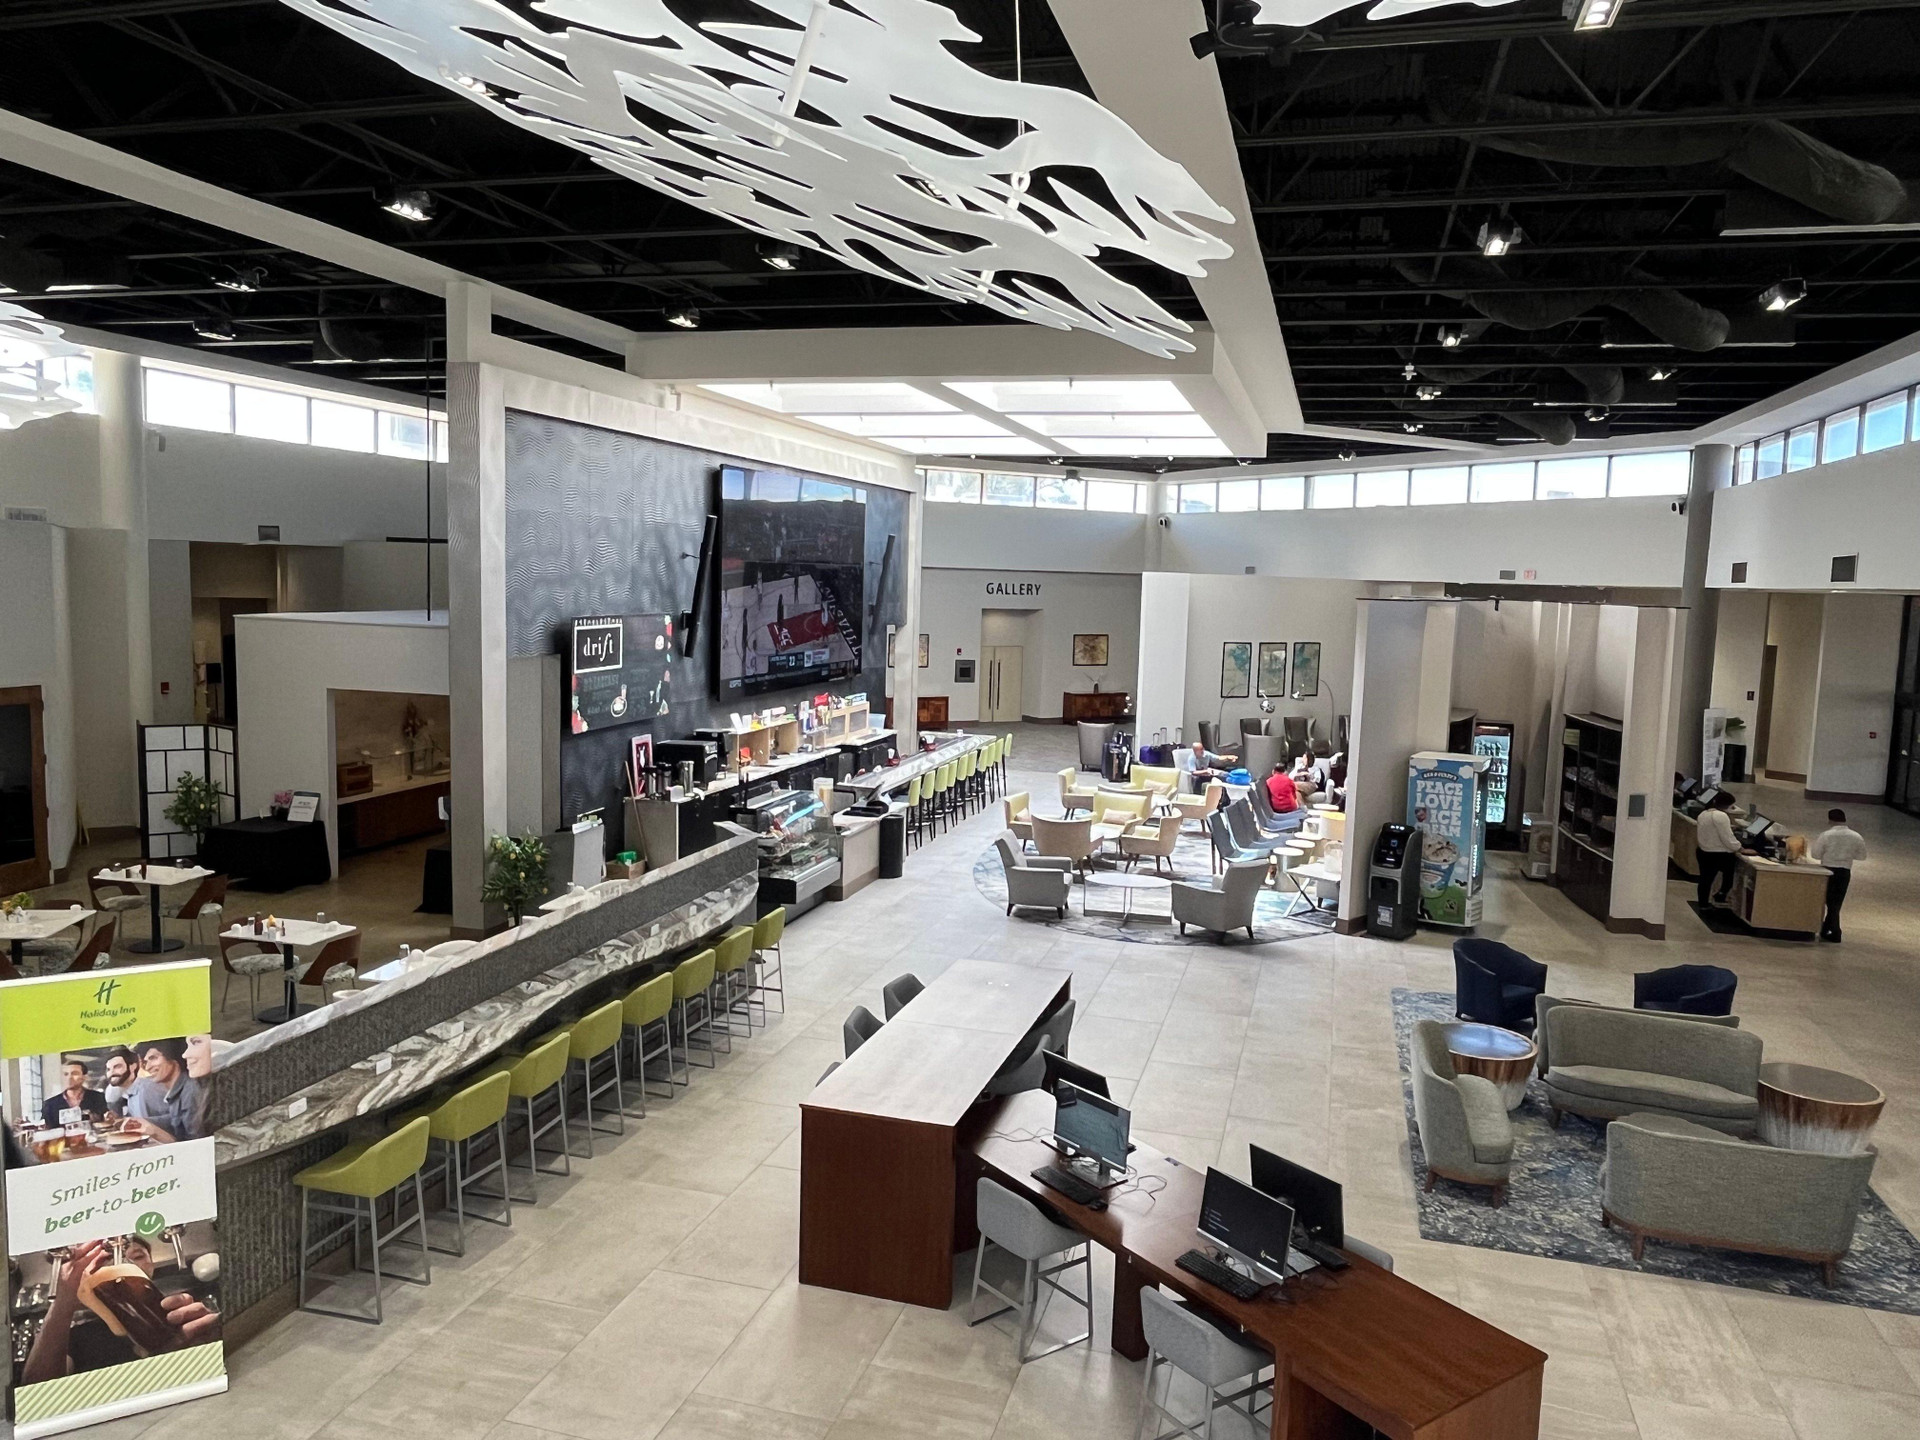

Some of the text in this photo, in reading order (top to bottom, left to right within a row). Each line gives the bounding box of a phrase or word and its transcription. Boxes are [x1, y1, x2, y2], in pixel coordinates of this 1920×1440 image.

[985, 582, 1042, 596] GALLERY
[583, 632, 613, 662] drift
[1416, 780, 1463, 795] PEACE
[1415, 793, 1463, 811] LOVE
[1430, 809, 1462, 825] ICE
[80, 1006, 136, 1018] Holiday Inn
[50, 1154, 174, 1206] Smiles from
[45, 1178, 181, 1234] beer-to-beer.
